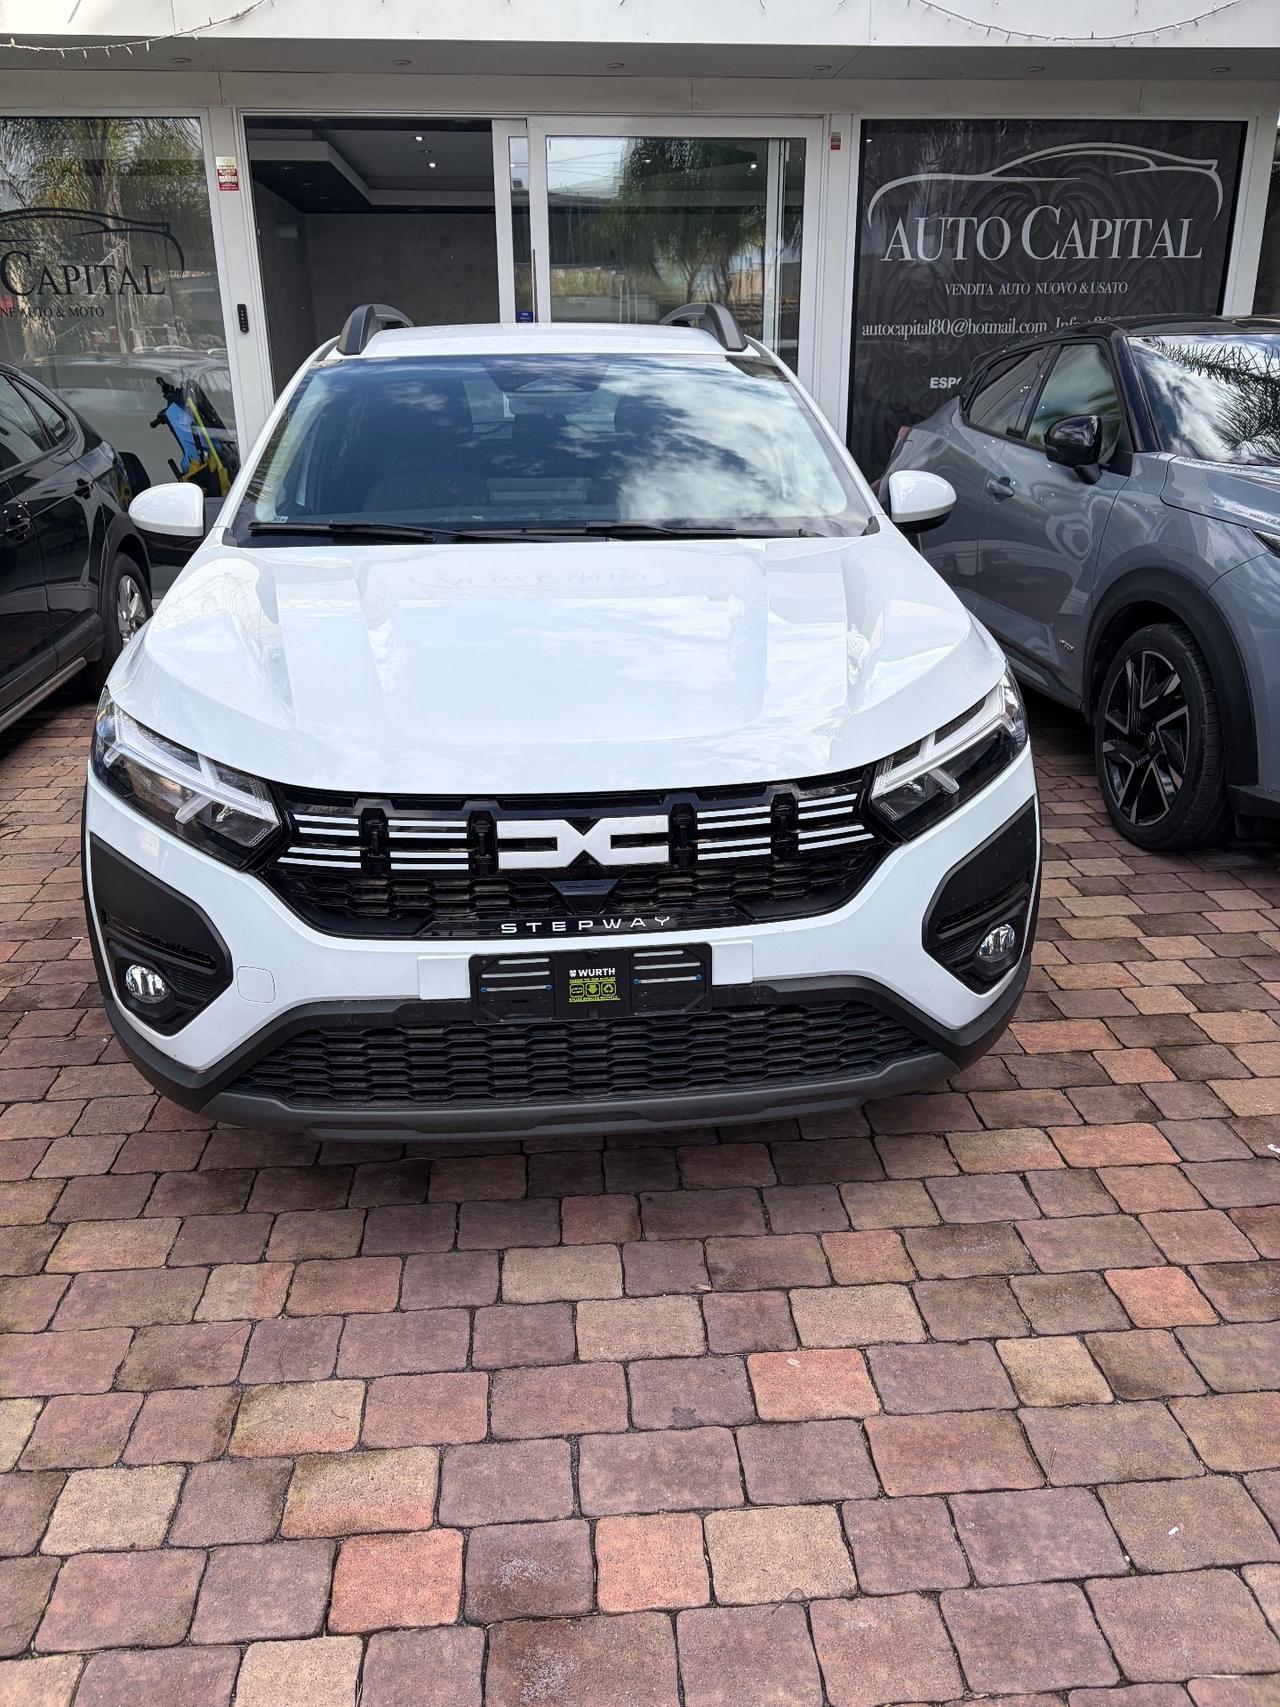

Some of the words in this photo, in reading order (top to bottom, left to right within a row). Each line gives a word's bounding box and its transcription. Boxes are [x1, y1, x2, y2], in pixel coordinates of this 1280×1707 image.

[880, 217, 1011, 260] AUTO
[1021, 205, 1202, 260] CAPITAL
[945, 282, 993, 296] VENDITA
[999, 282, 1030, 296] AUTO
[1035, 281, 1077, 296] NUOVO
[1079, 282, 1089, 295] &
[1091, 281, 1128, 295] USATO
[20, 306, 53, 318] AUTO
[56, 307, 65, 318] &
[68, 306, 105, 318] MOTO
[862, 318, 1047, 340] autocapital80@hotmail.com
[501, 916, 670, 933] STEPWAY
[578, 967, 616, 977] WURTH
